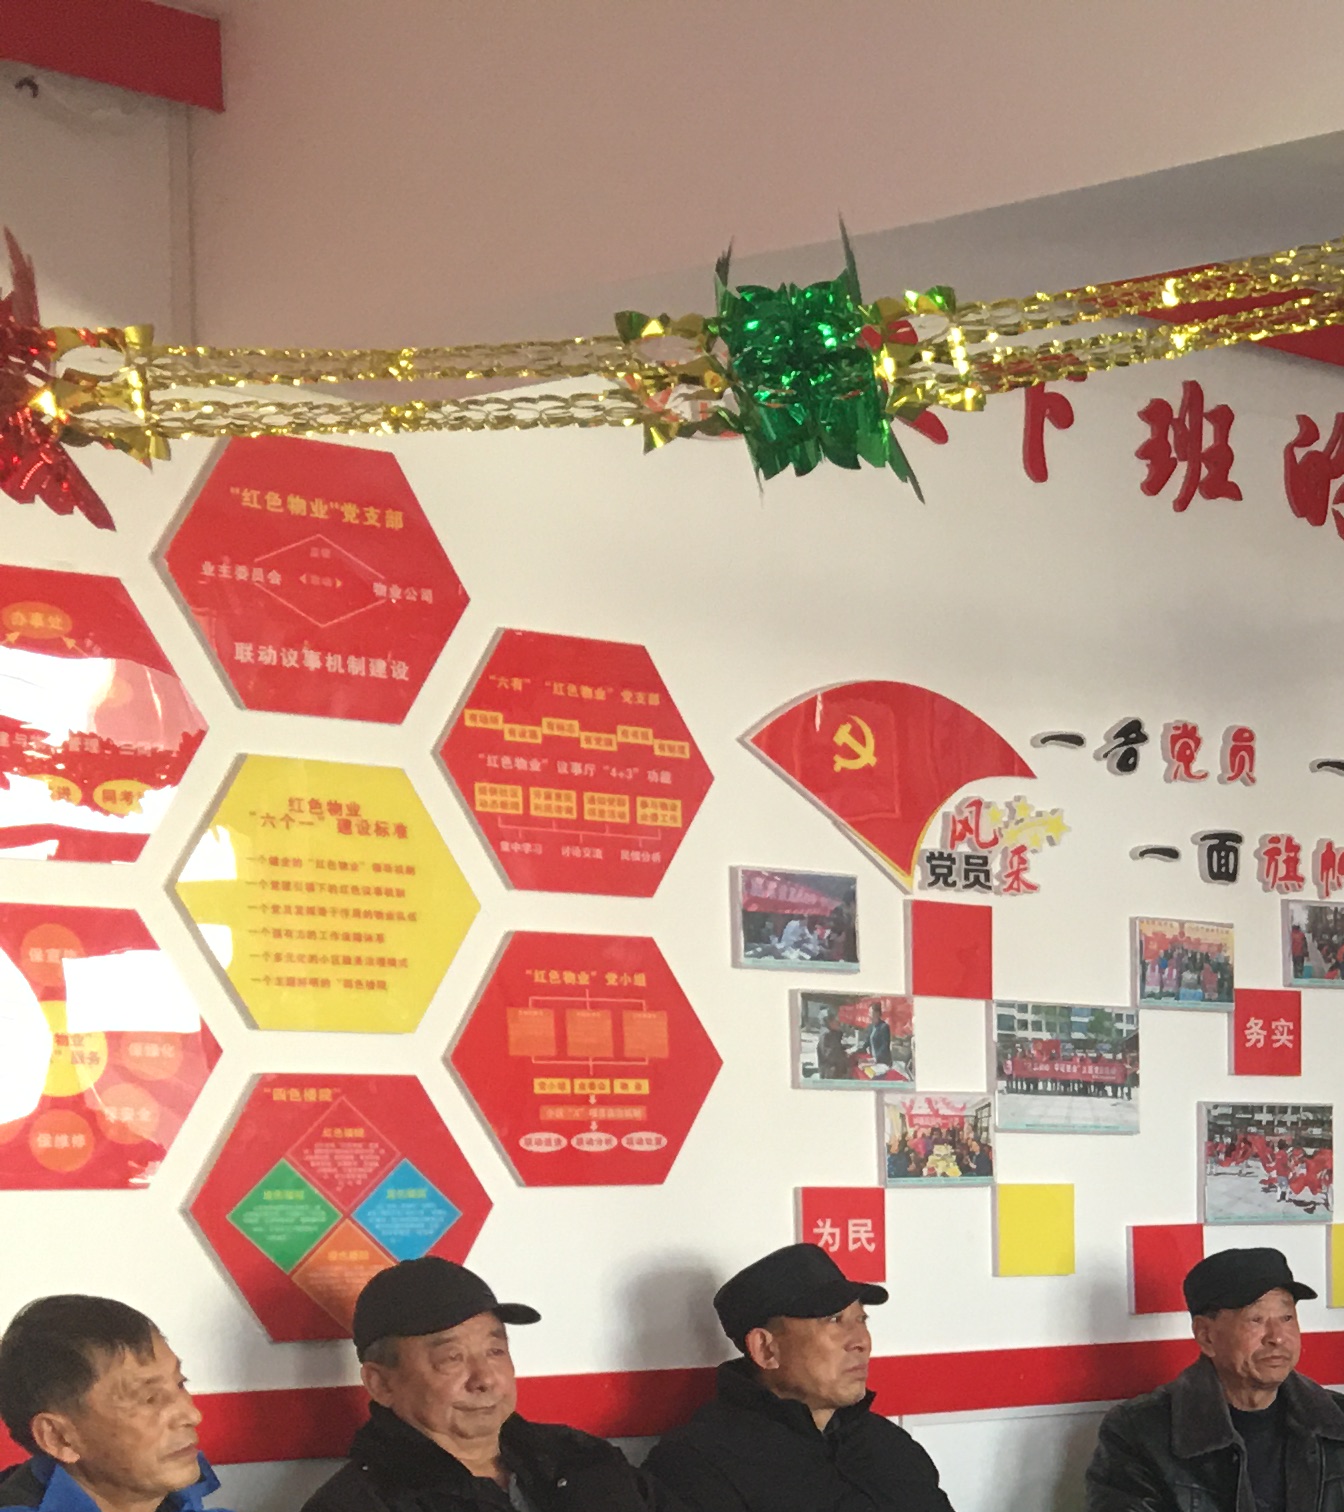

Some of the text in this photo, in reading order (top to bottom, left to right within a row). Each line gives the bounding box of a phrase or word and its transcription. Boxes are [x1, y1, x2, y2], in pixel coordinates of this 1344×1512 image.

[201, 561, 282, 585] 业主委员会
[372, 582, 433, 605] 物业公司
[234, 641, 410, 681] 联动议事机制建设
[1040, 718, 1257, 785] 一名党员
[288, 797, 362, 817] 红色物业
[925, 850, 992, 889] 党员
[1243, 1017, 1295, 1049] 务实
[813, 1217, 876, 1253] 为民
